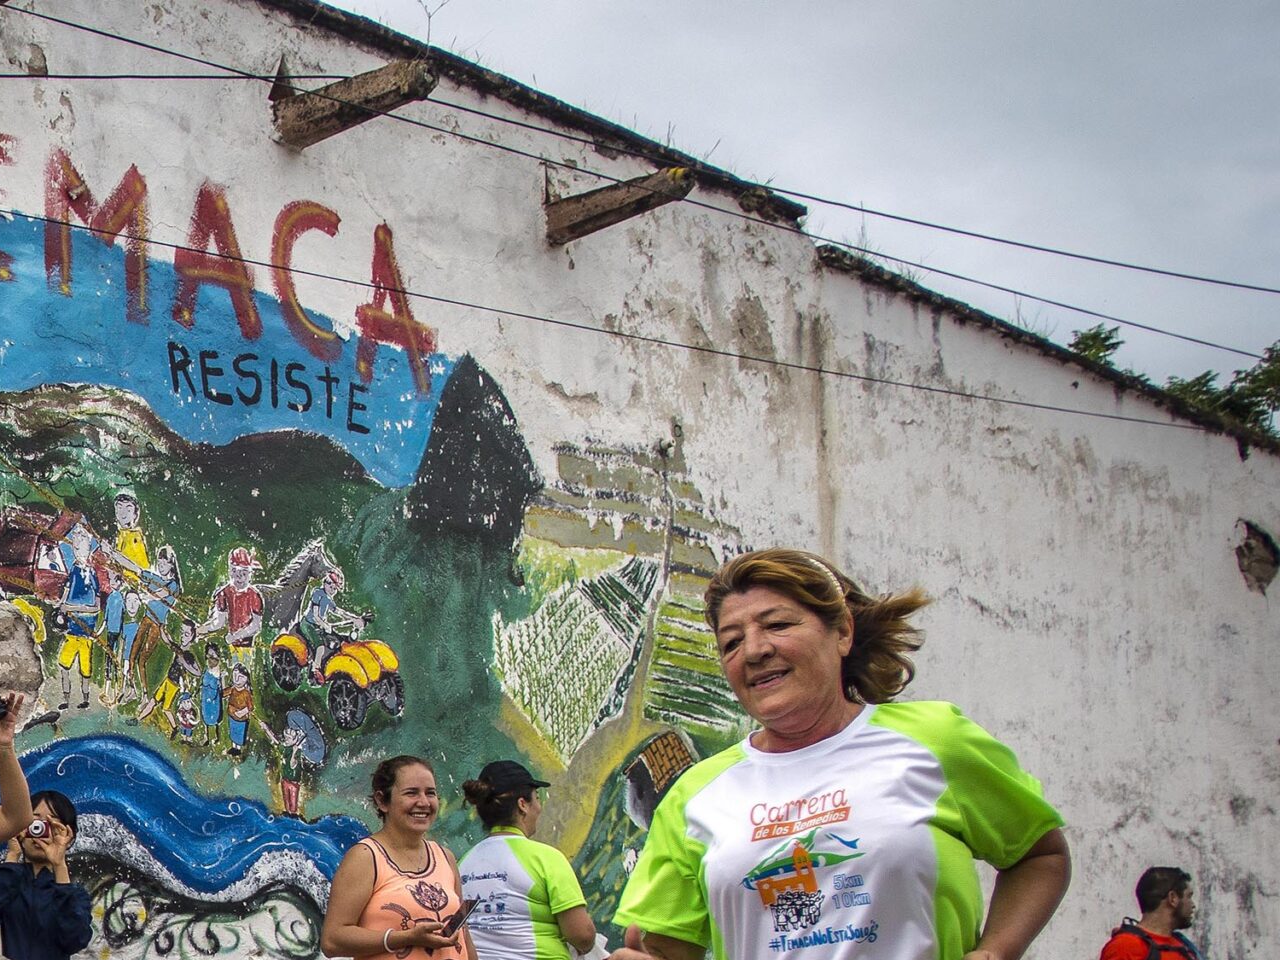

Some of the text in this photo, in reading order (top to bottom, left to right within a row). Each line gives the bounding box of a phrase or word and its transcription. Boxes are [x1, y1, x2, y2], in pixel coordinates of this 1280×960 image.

[750, 787, 849, 827] Carrera
[754, 810, 847, 839] de los Remedios
[833, 873, 865, 891] 5km
